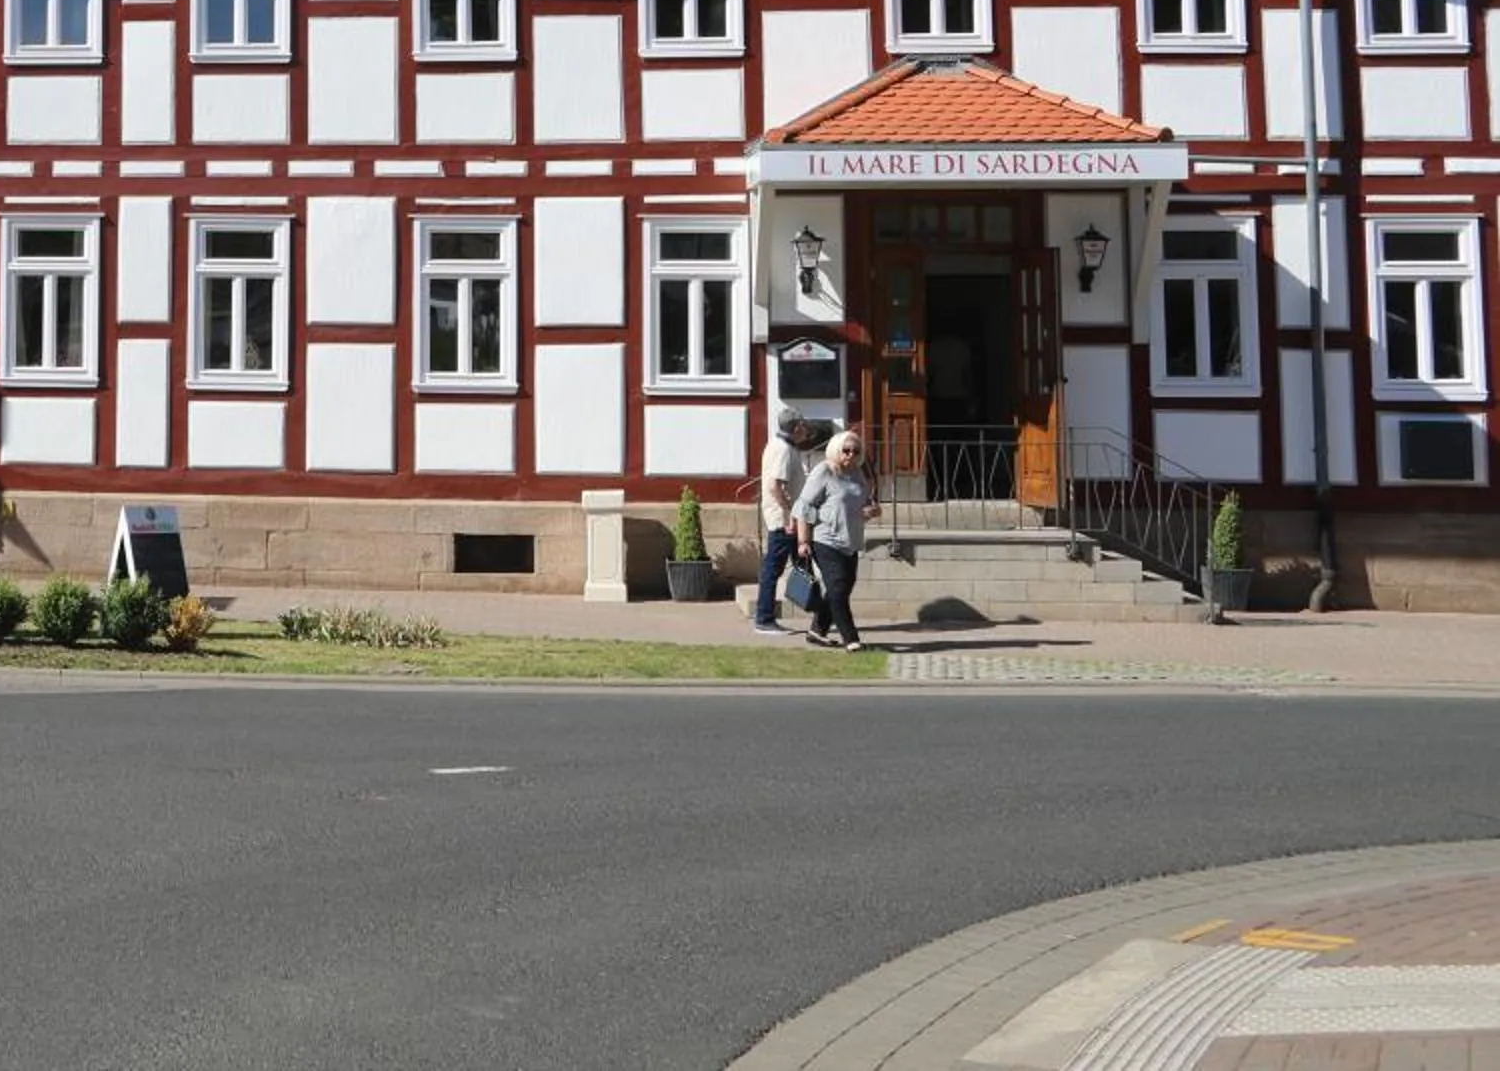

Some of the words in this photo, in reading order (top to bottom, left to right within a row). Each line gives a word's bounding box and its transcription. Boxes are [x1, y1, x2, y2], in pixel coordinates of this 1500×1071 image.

[841, 153, 924, 175] MARE
[933, 153, 966, 175] DI
[976, 151, 1140, 175] SARDEGNA
